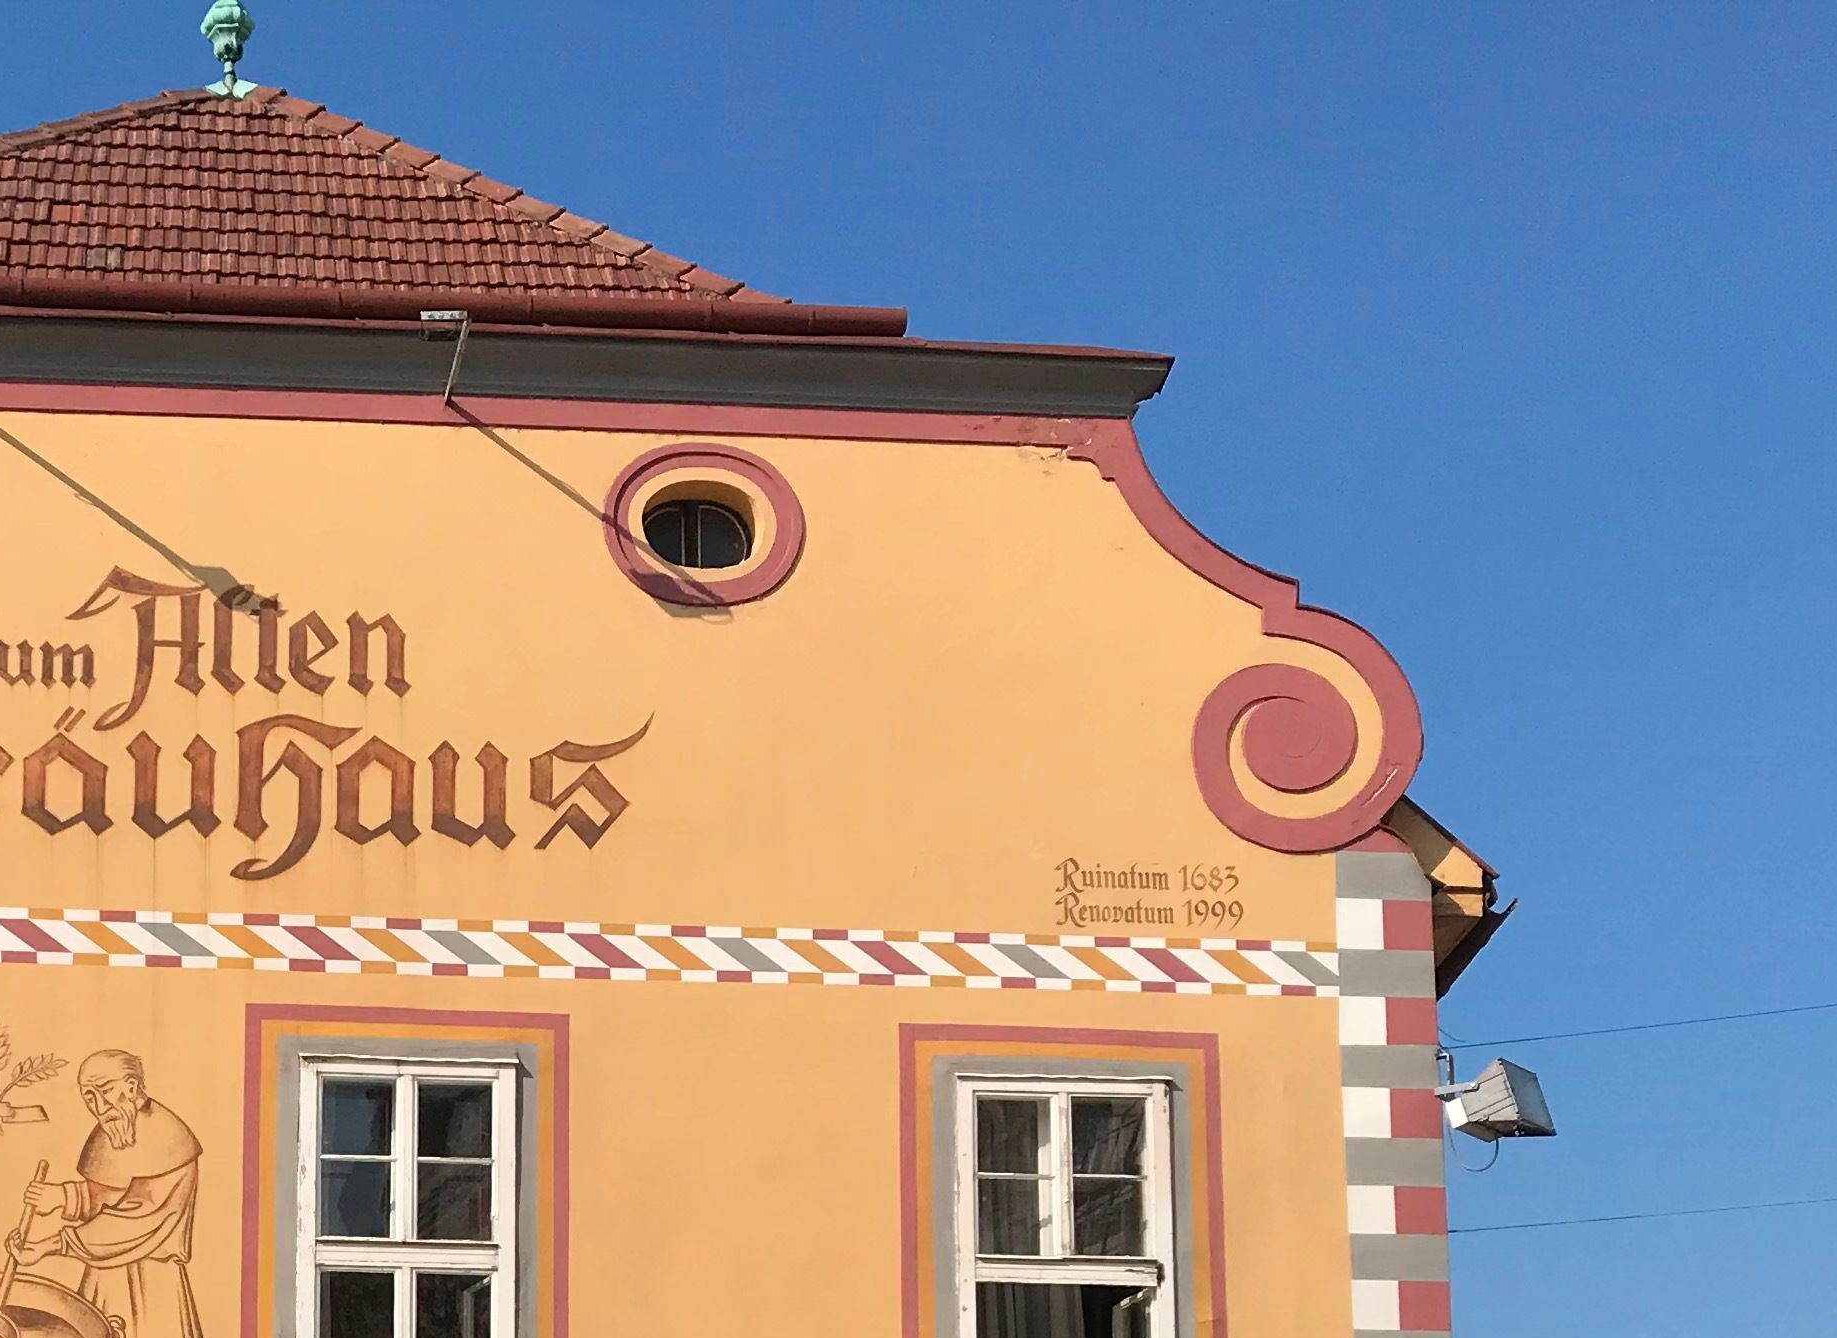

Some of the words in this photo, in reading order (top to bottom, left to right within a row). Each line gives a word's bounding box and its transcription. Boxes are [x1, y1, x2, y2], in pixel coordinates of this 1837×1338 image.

[66, 565, 411, 731] Alten
[1055, 857, 1170, 893] Ruinatum
[1178, 863, 1240, 894] 1683
[1055, 891, 1175, 928] Renovatum
[1182, 899, 1244, 931] 1999
